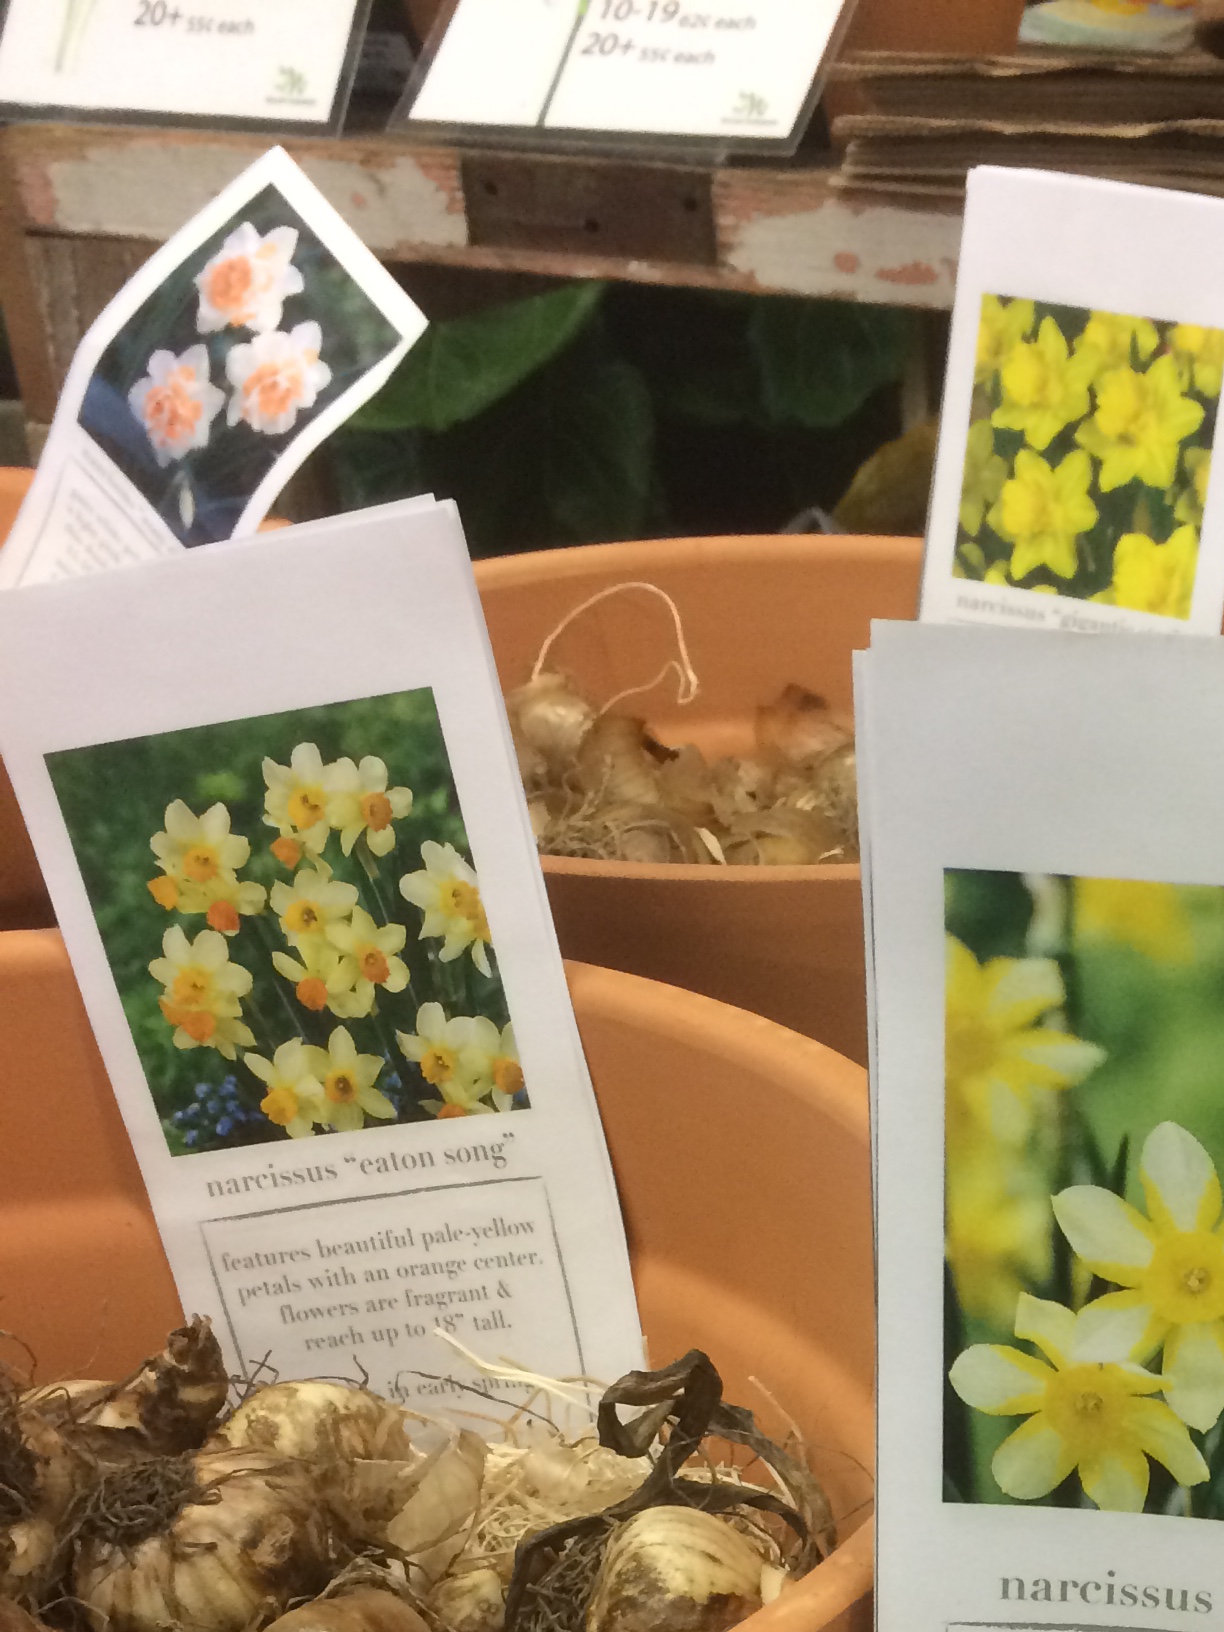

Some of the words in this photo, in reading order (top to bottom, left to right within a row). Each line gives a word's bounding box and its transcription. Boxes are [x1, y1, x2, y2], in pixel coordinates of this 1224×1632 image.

[134, 0, 183, 26] 20+
[217, 18, 255, 34] each
[714, 15, 757, 30] each
[582, 32, 635, 56] 20+
[673, 50, 716, 65] each
[957, 593, 1047, 623] narcissus
[206, 1163, 338, 1198] narcissus
[344, 1148, 435, 1177] “eaton
[443, 1132, 516, 1170] song”
[221, 1240, 311, 1273] features
[316, 1227, 415, 1258] beautiful
[421, 1218, 536, 1252] pale-yellow
[237, 1276, 302, 1306] petals
[307, 1266, 357, 1291] with
[364, 1266, 390, 1283] an
[396, 1257, 468, 1282] orange
[473, 1249, 544, 1272] center.
[280, 1298, 360, 1326] flowers
[365, 1294, 399, 1313] are
[405, 1285, 489, 1308] fragrant
[496, 1282, 512, 1299] &
[304, 1326, 364, 1352] reach
[371, 1328, 399, 1347] up
[405, 1322, 426, 1338] to
[472, 1310, 512, 1331] tall.
[1000, 1571, 1213, 1615] narcissus
